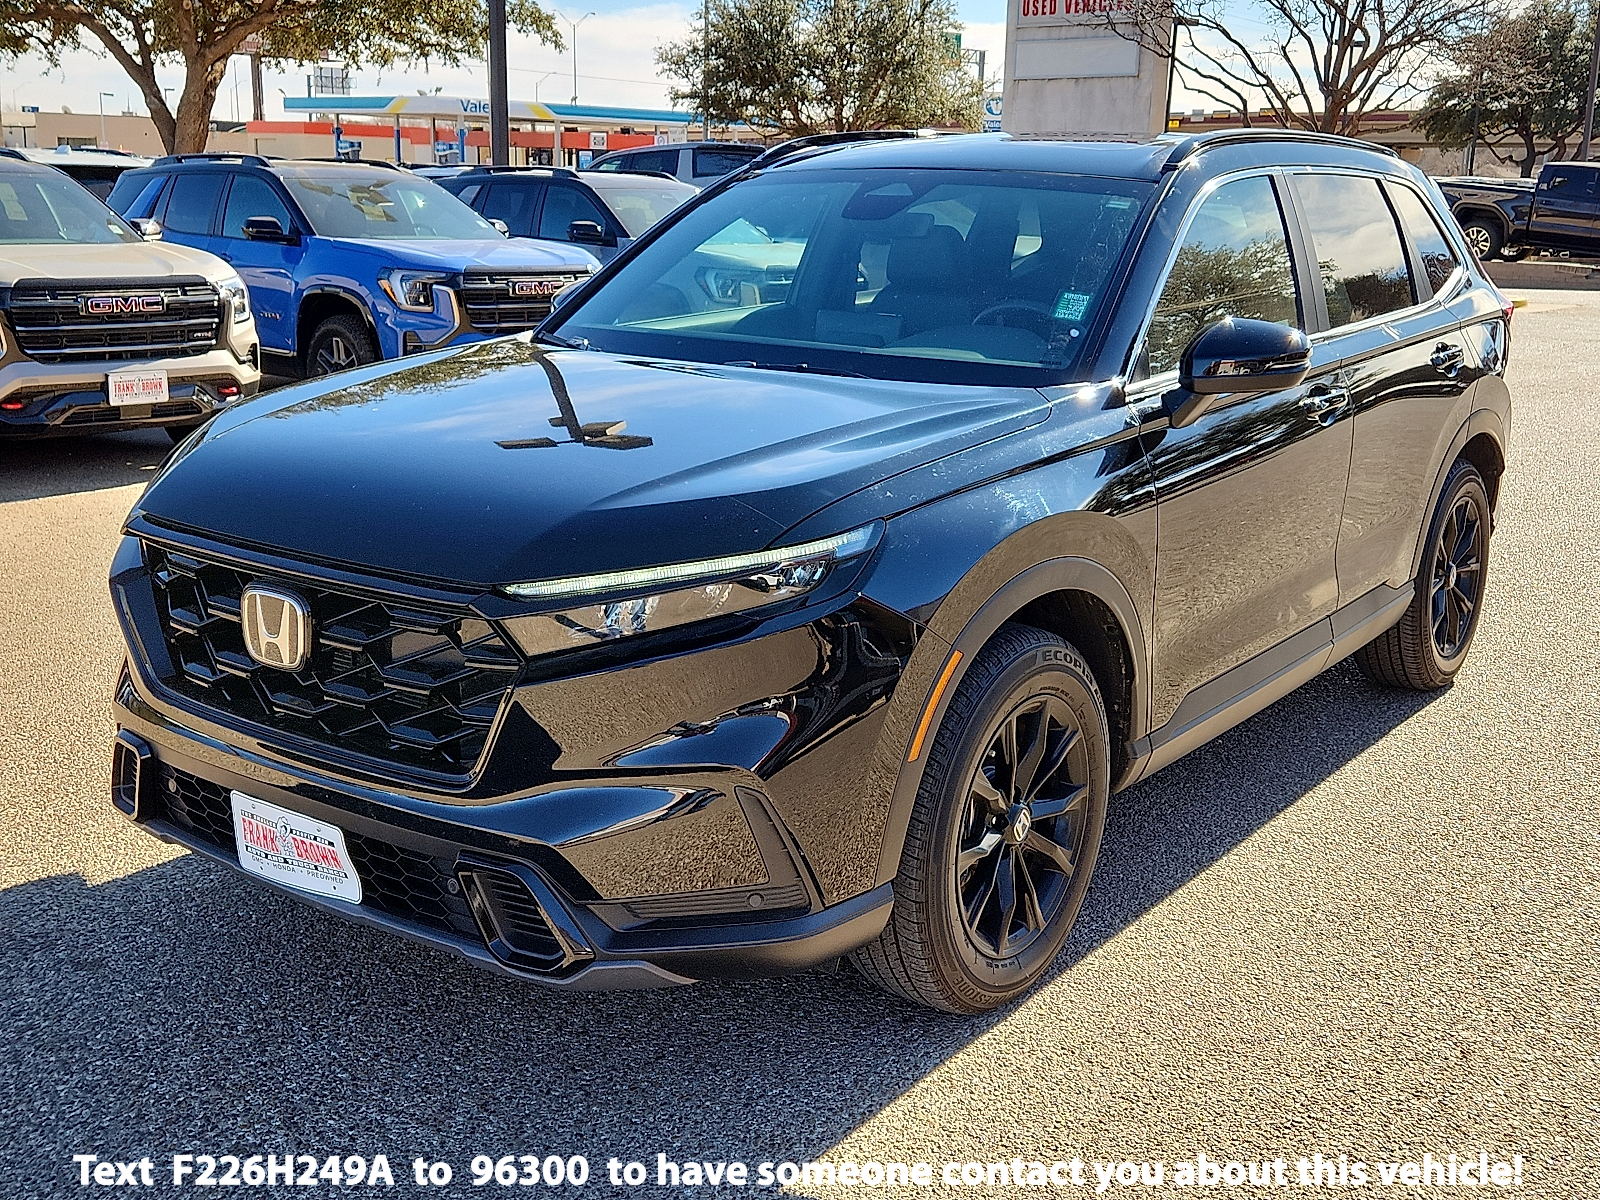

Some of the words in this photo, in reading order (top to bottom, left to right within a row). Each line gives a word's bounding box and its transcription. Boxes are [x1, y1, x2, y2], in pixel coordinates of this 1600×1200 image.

[1022, 0, 1057, 17] USED
[984, 120, 1002, 129] Vale
[515, 281, 564, 295] GMC
[88, 296, 163, 313] GMC
[114, 382, 135, 394] FRANK
[141, 380, 163, 392] BROWN
[241, 817, 281, 854] FRANK
[291, 835, 344, 871] BROWN
[247, 847, 266, 858] AUTO
[267, 854, 285, 864] AND
[286, 858, 316, 871] TRUCK
[272, 862, 297, 874] HONDA
[306, 870, 344, 885] PREOWNED
